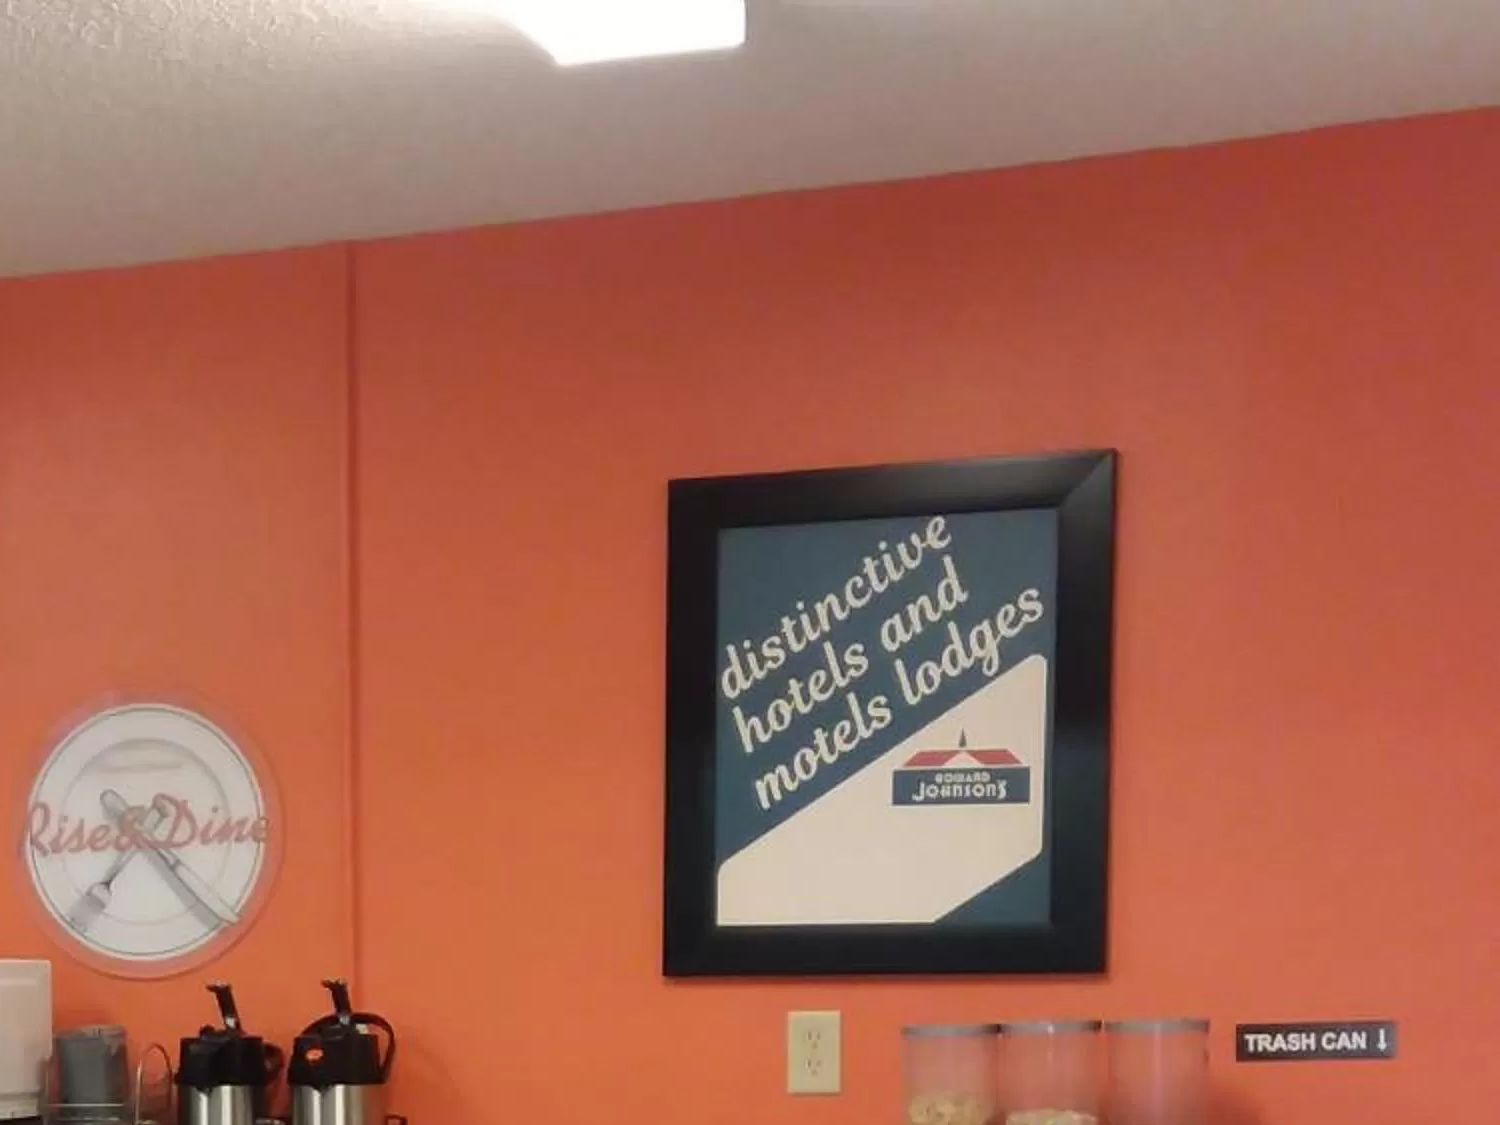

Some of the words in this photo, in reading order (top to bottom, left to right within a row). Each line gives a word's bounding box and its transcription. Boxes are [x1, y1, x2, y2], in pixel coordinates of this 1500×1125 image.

[719, 515, 952, 698] distinctive
[733, 640, 869, 753] hotels
[881, 555, 969, 652] and
[754, 692, 893, 810] motels
[896, 587, 1044, 705] lodges
[30, 801, 114, 858] Rise
[148, 792, 270, 851] Dine
[935, 771, 991, 784] HOWARD
[1244, 1032, 1316, 1053] TRASH
[1321, 1030, 1367, 1050] CAN
